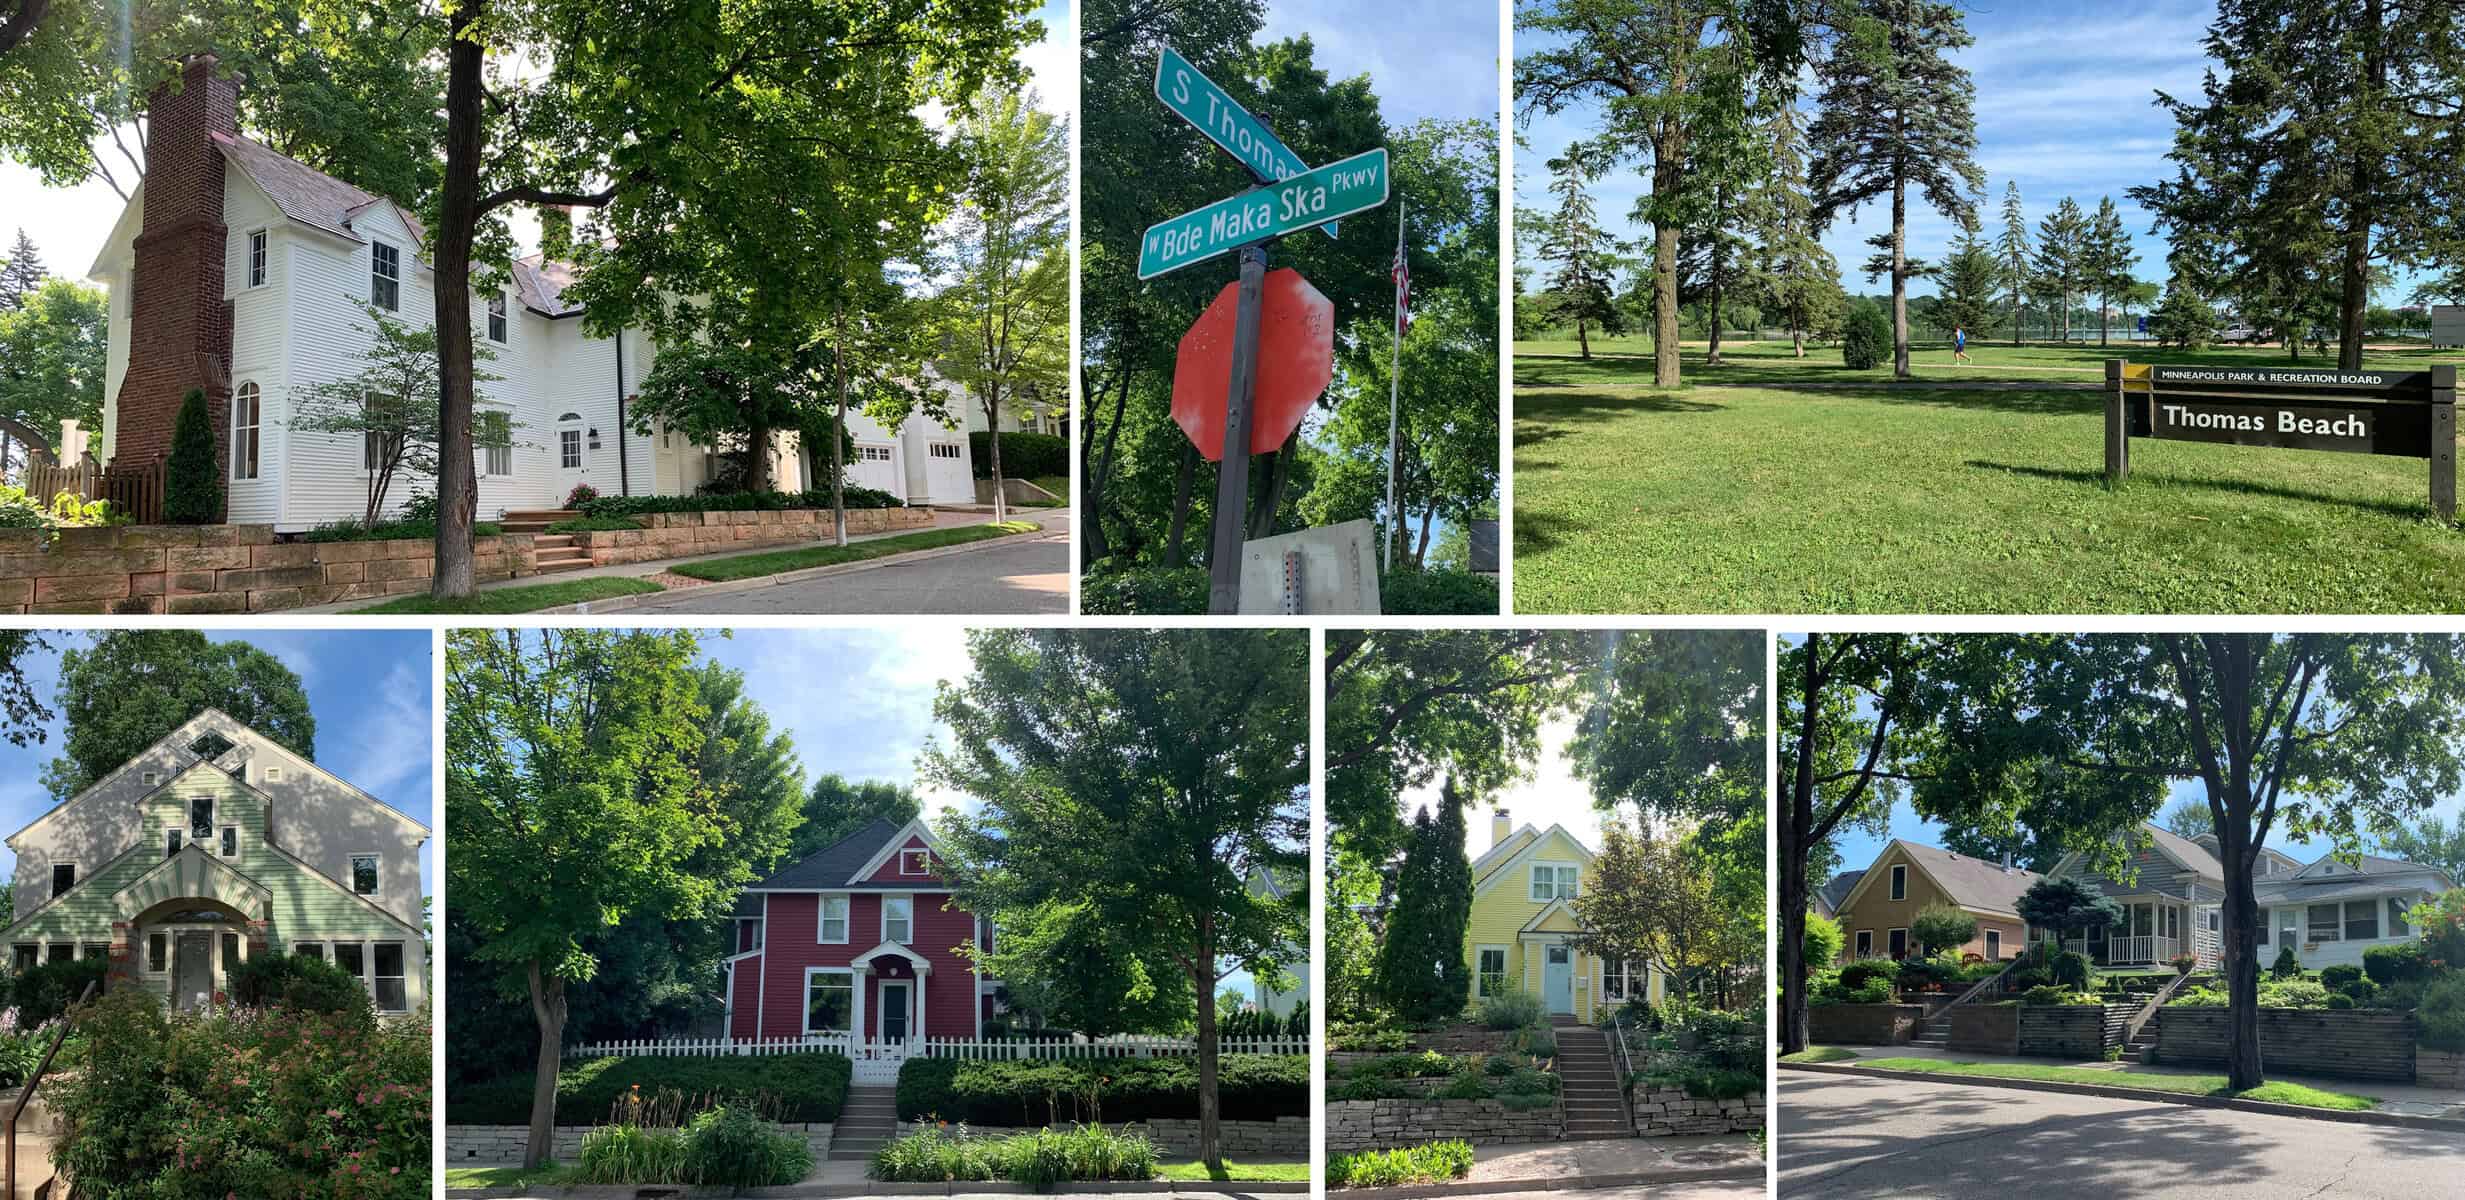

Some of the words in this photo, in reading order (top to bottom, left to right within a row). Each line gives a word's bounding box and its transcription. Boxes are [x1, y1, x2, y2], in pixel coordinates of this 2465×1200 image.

[1172, 69, 1192, 105] S
[1150, 233, 1161, 254] W
[1162, 224, 1203, 262] Bde
[1210, 202, 1271, 246] Maka
[1280, 184, 1326, 222] Ska
[1332, 164, 1378, 194] Pkwy
[2162, 371, 2225, 380] MINNEAPOLIS
[2228, 372, 2254, 382] PARK
[2258, 374, 2266, 382] &
[2270, 374, 2337, 384] RECREATION
[2341, 375, 2382, 385] BOARD
[2163, 405, 2265, 431] Thomas
[2278, 410, 2366, 437] Beach
